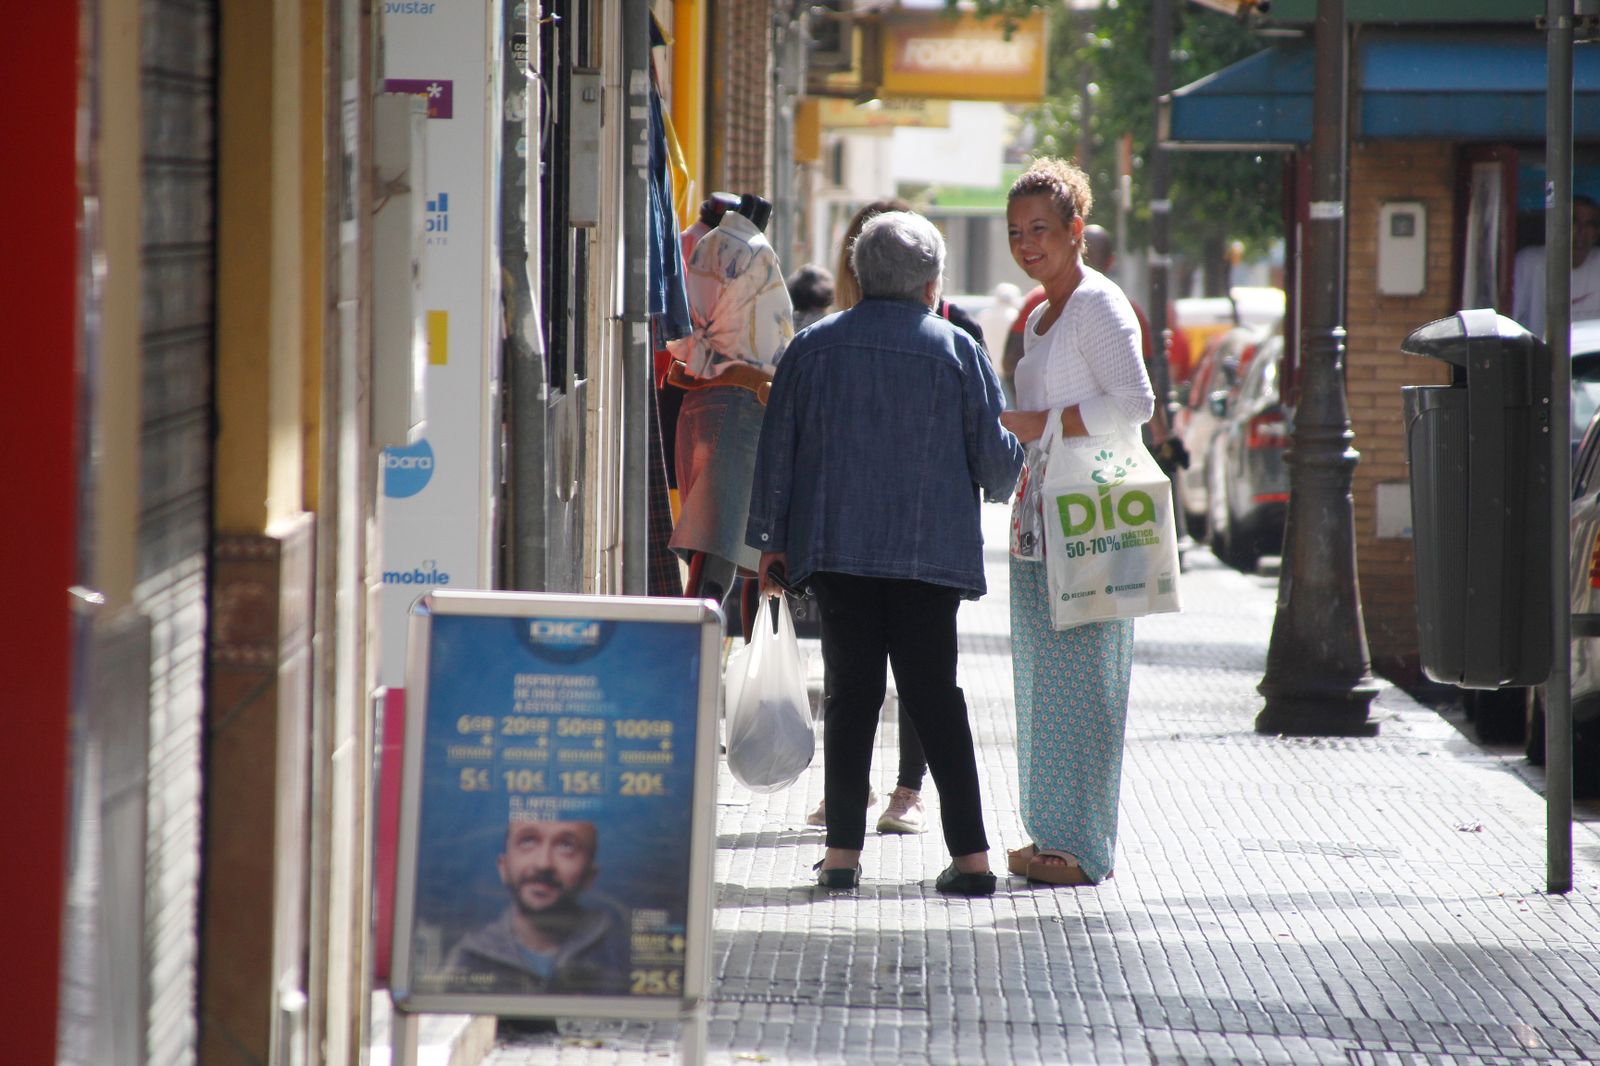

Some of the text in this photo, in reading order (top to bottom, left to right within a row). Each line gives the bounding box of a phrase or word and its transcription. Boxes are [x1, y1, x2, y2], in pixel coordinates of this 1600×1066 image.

[1066, 534, 1121, 559] 50-70%
[383, 567, 449, 585] mobile
[630, 969, 680, 994] 25€
